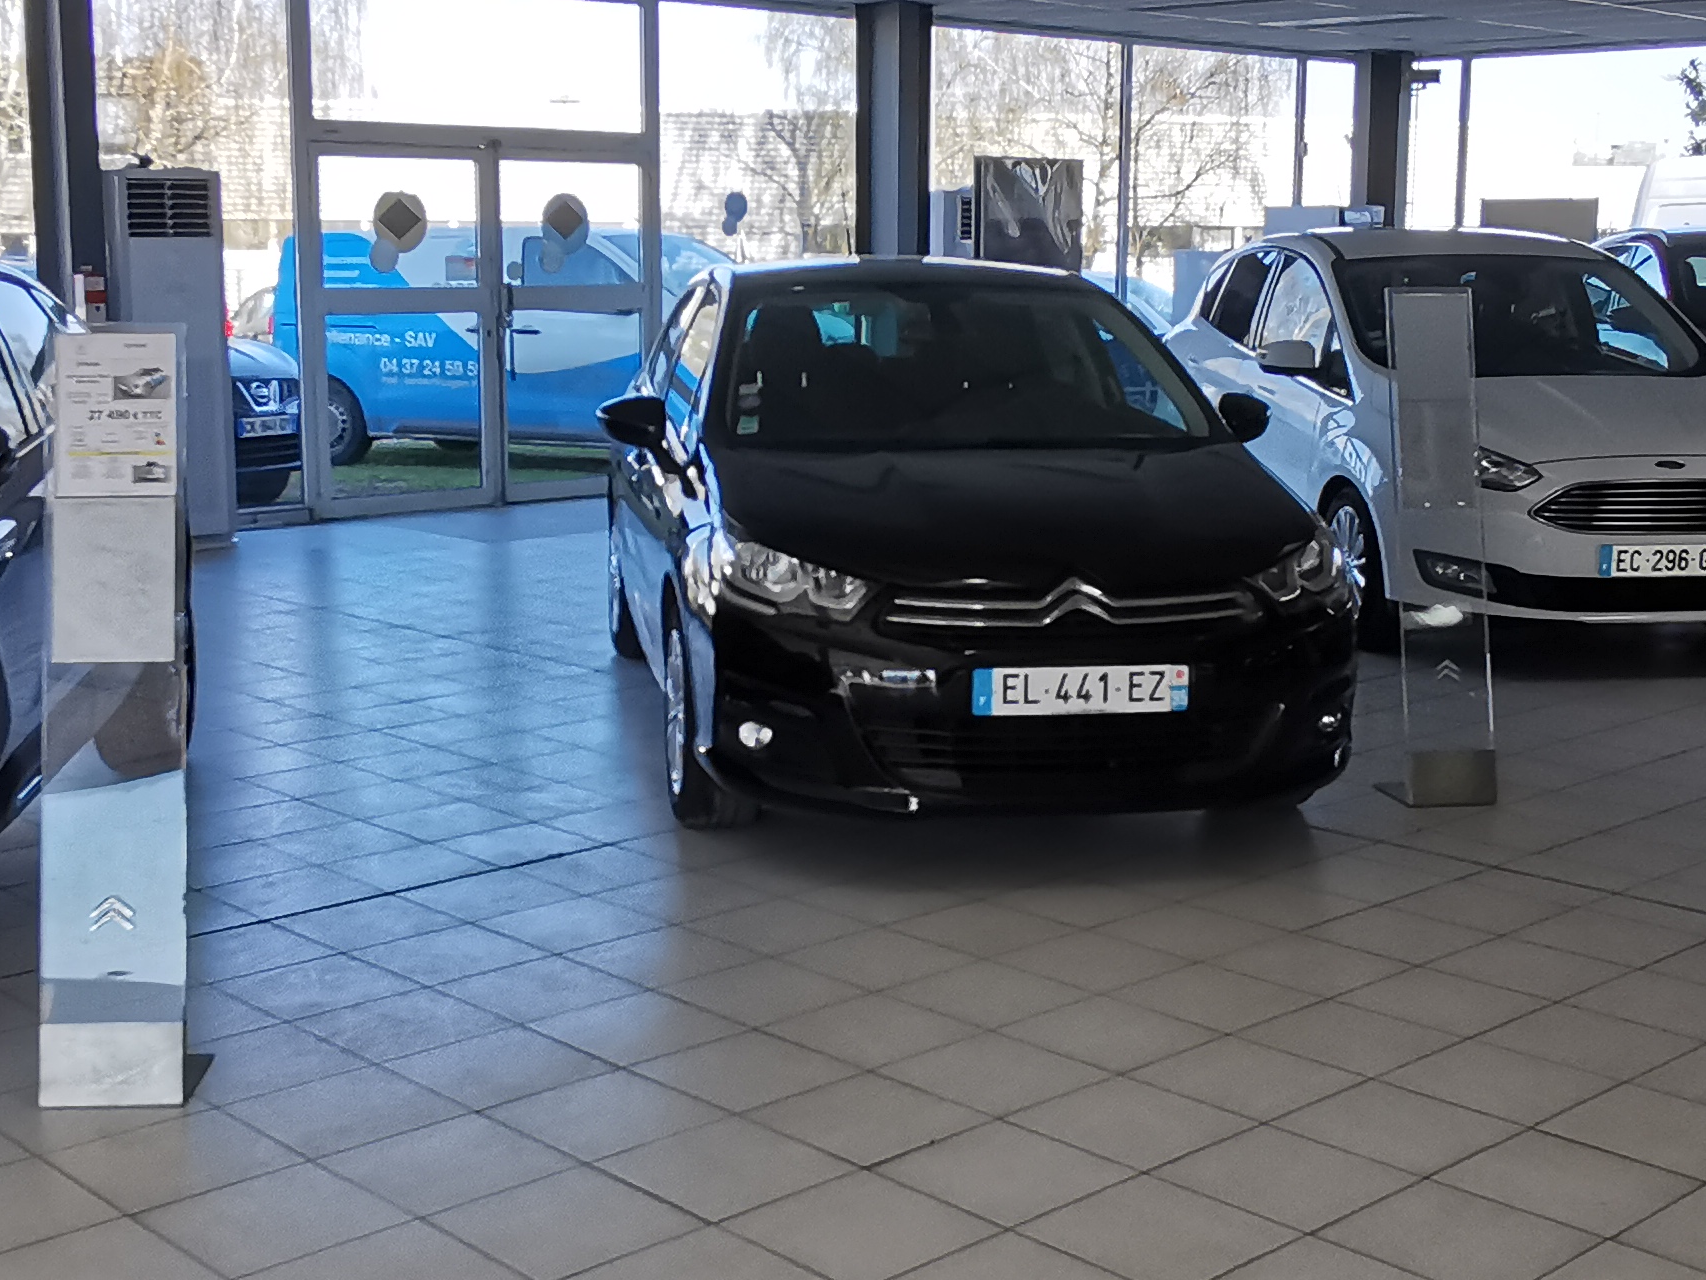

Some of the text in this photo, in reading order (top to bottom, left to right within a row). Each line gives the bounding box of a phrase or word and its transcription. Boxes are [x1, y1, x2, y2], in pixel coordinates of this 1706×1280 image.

[404, 330, 437, 348] SAV
[401, 358, 420, 374] 37
[423, 359, 441, 375] 24
